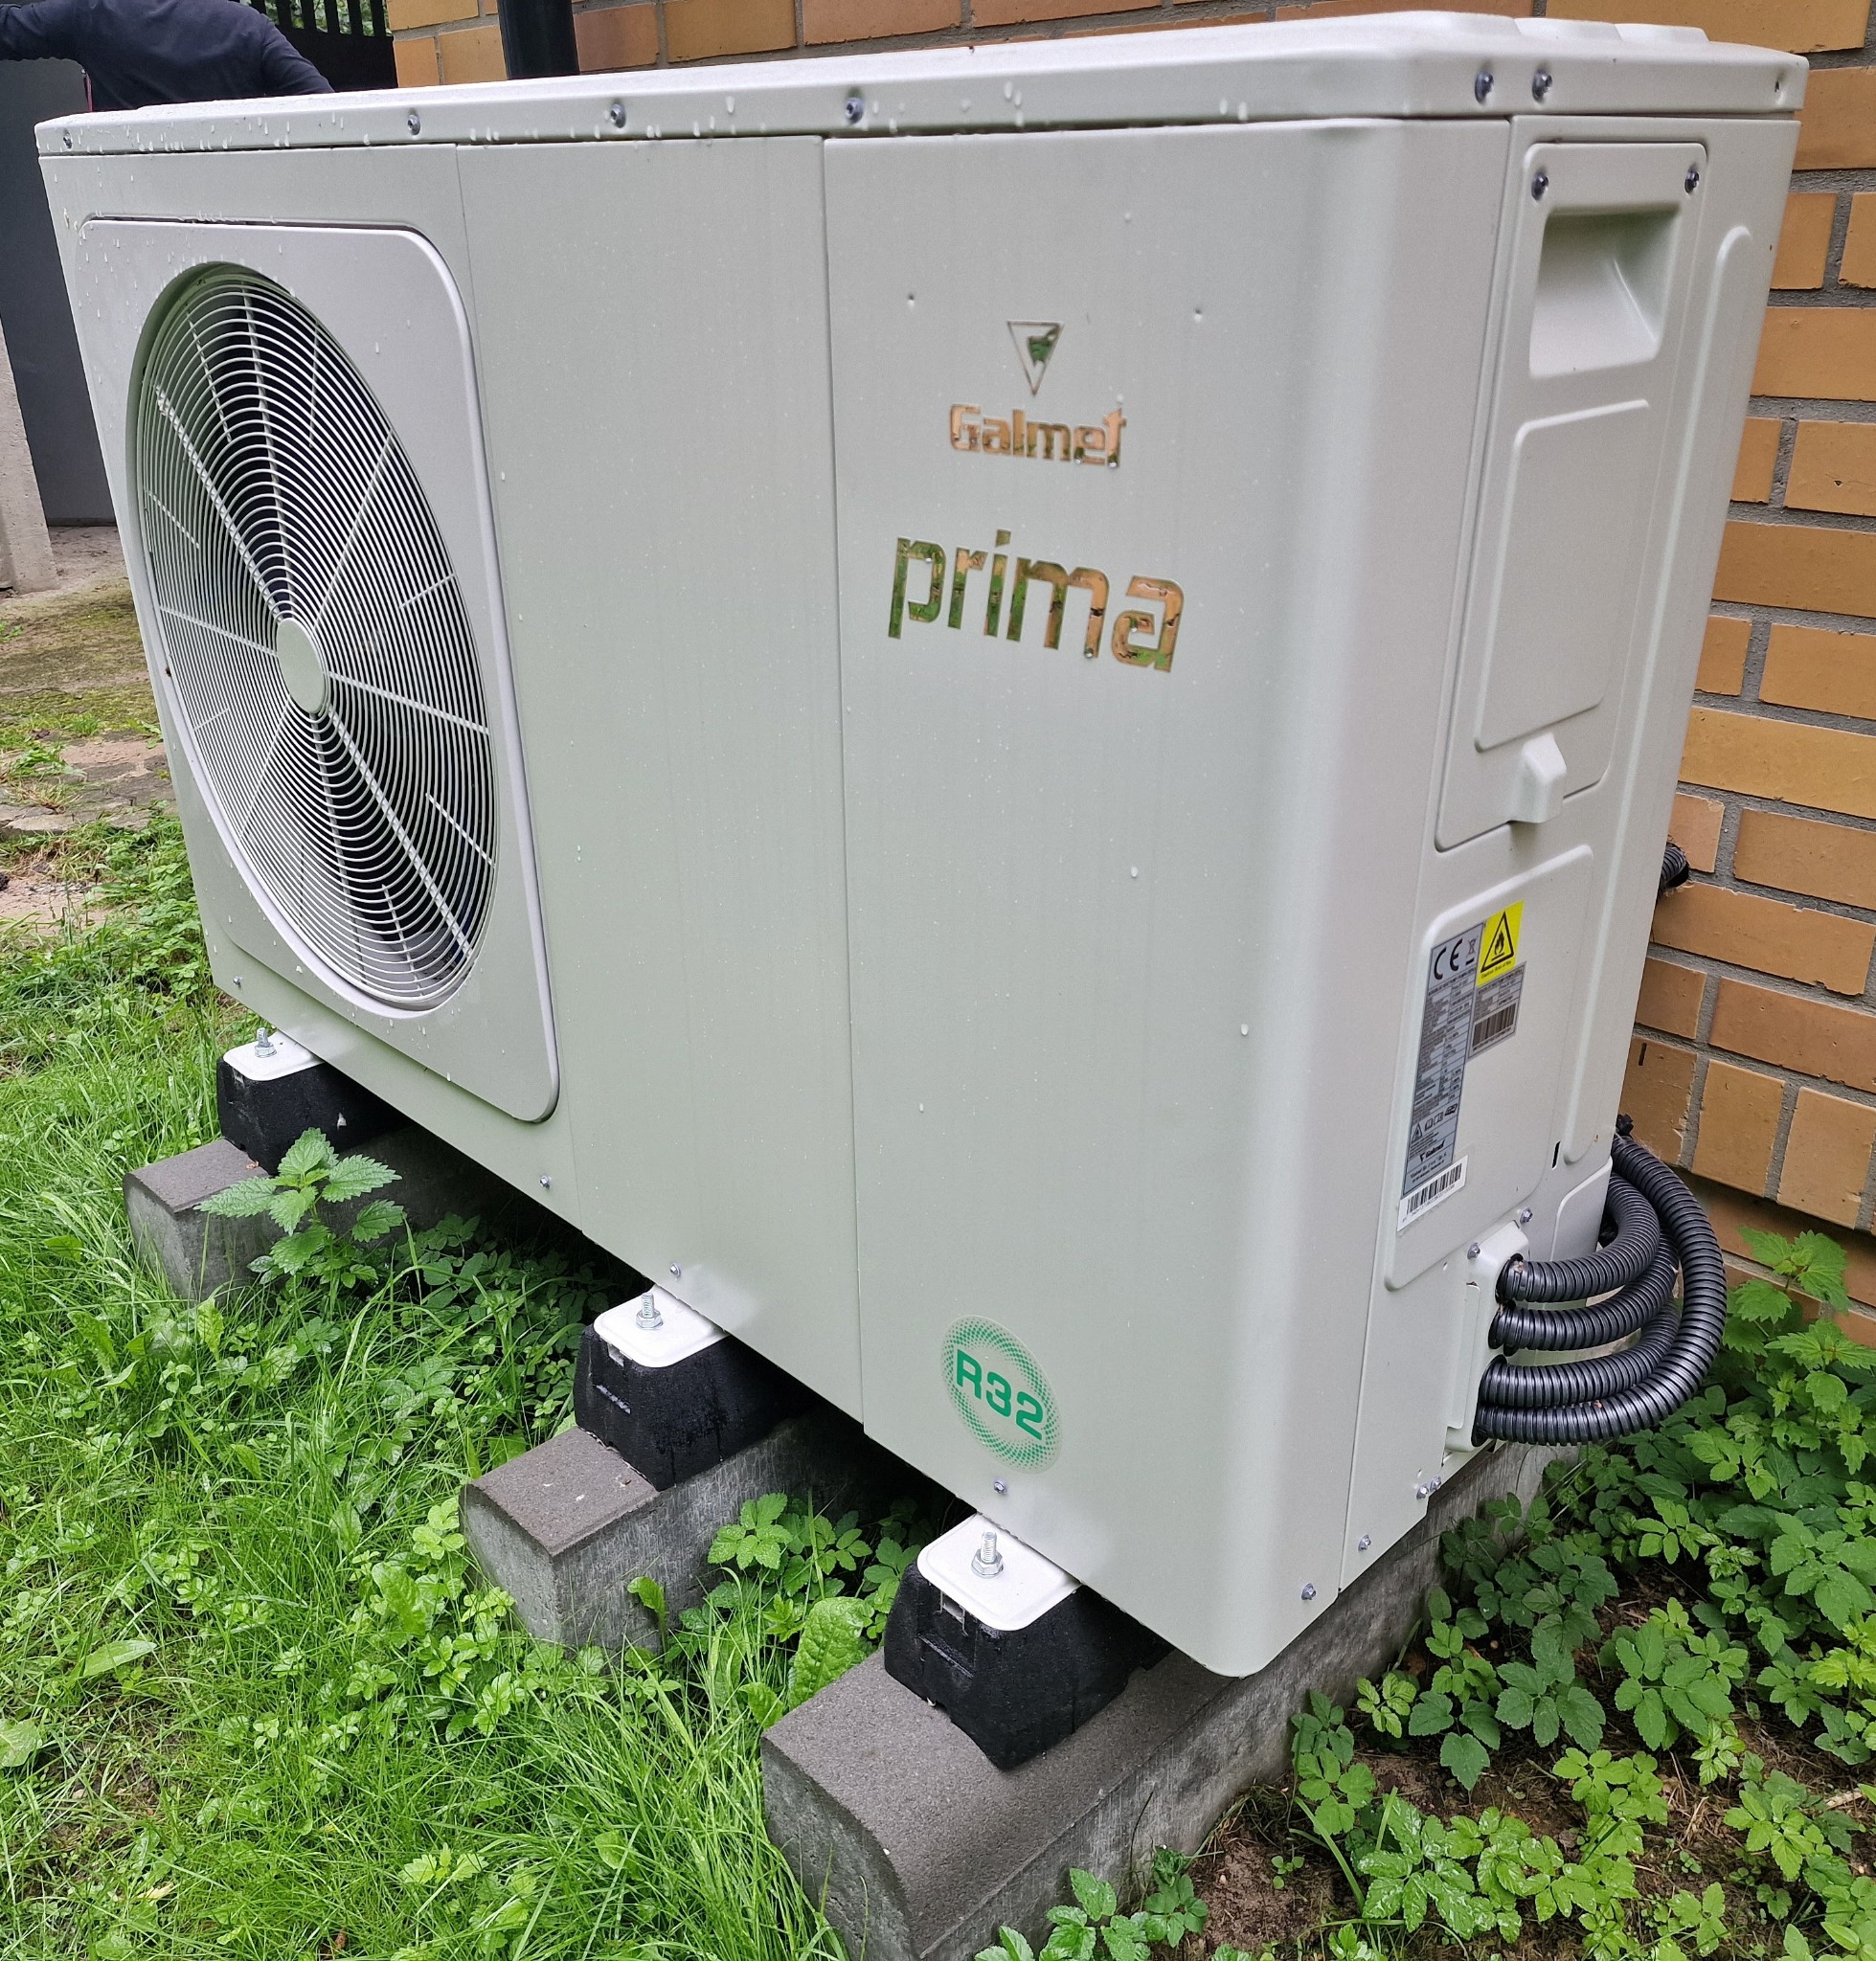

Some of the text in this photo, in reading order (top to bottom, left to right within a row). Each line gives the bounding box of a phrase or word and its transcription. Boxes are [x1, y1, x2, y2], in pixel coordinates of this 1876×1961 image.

[949, 403, 1127, 468] Galmet
[888, 529, 1185, 672] prima
[1434, 938, 1463, 980] CE
[956, 1349, 1044, 1441] R32
